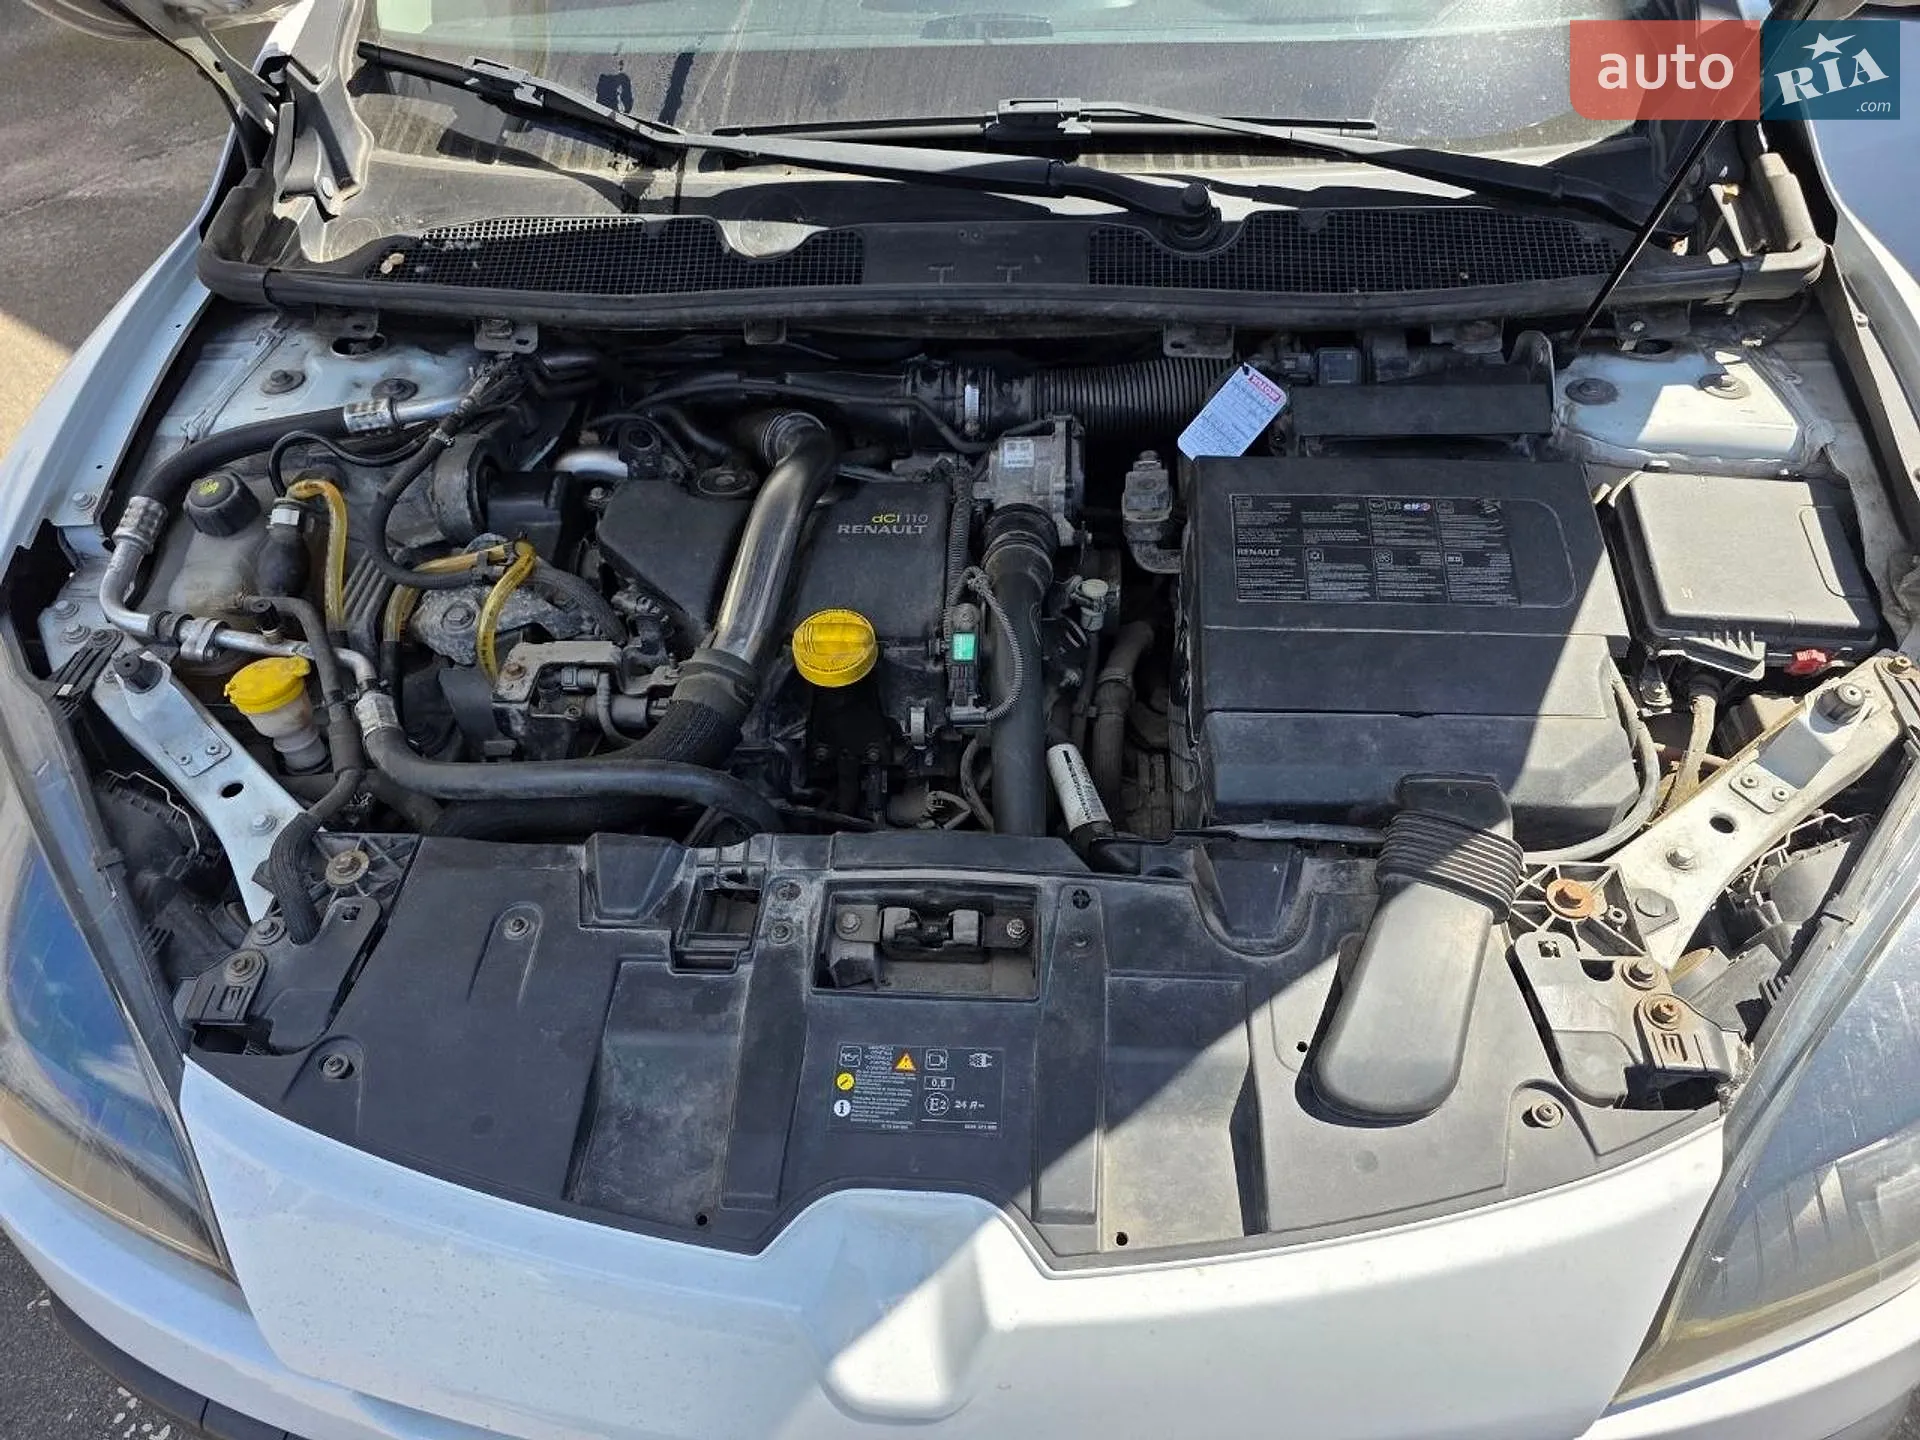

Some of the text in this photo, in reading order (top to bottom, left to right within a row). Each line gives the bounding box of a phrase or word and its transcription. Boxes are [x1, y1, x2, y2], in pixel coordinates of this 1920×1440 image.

[905, 513, 929, 524] 110
[837, 524, 928, 535] RENAULT
[1236, 548, 1281, 557] RENAULT
